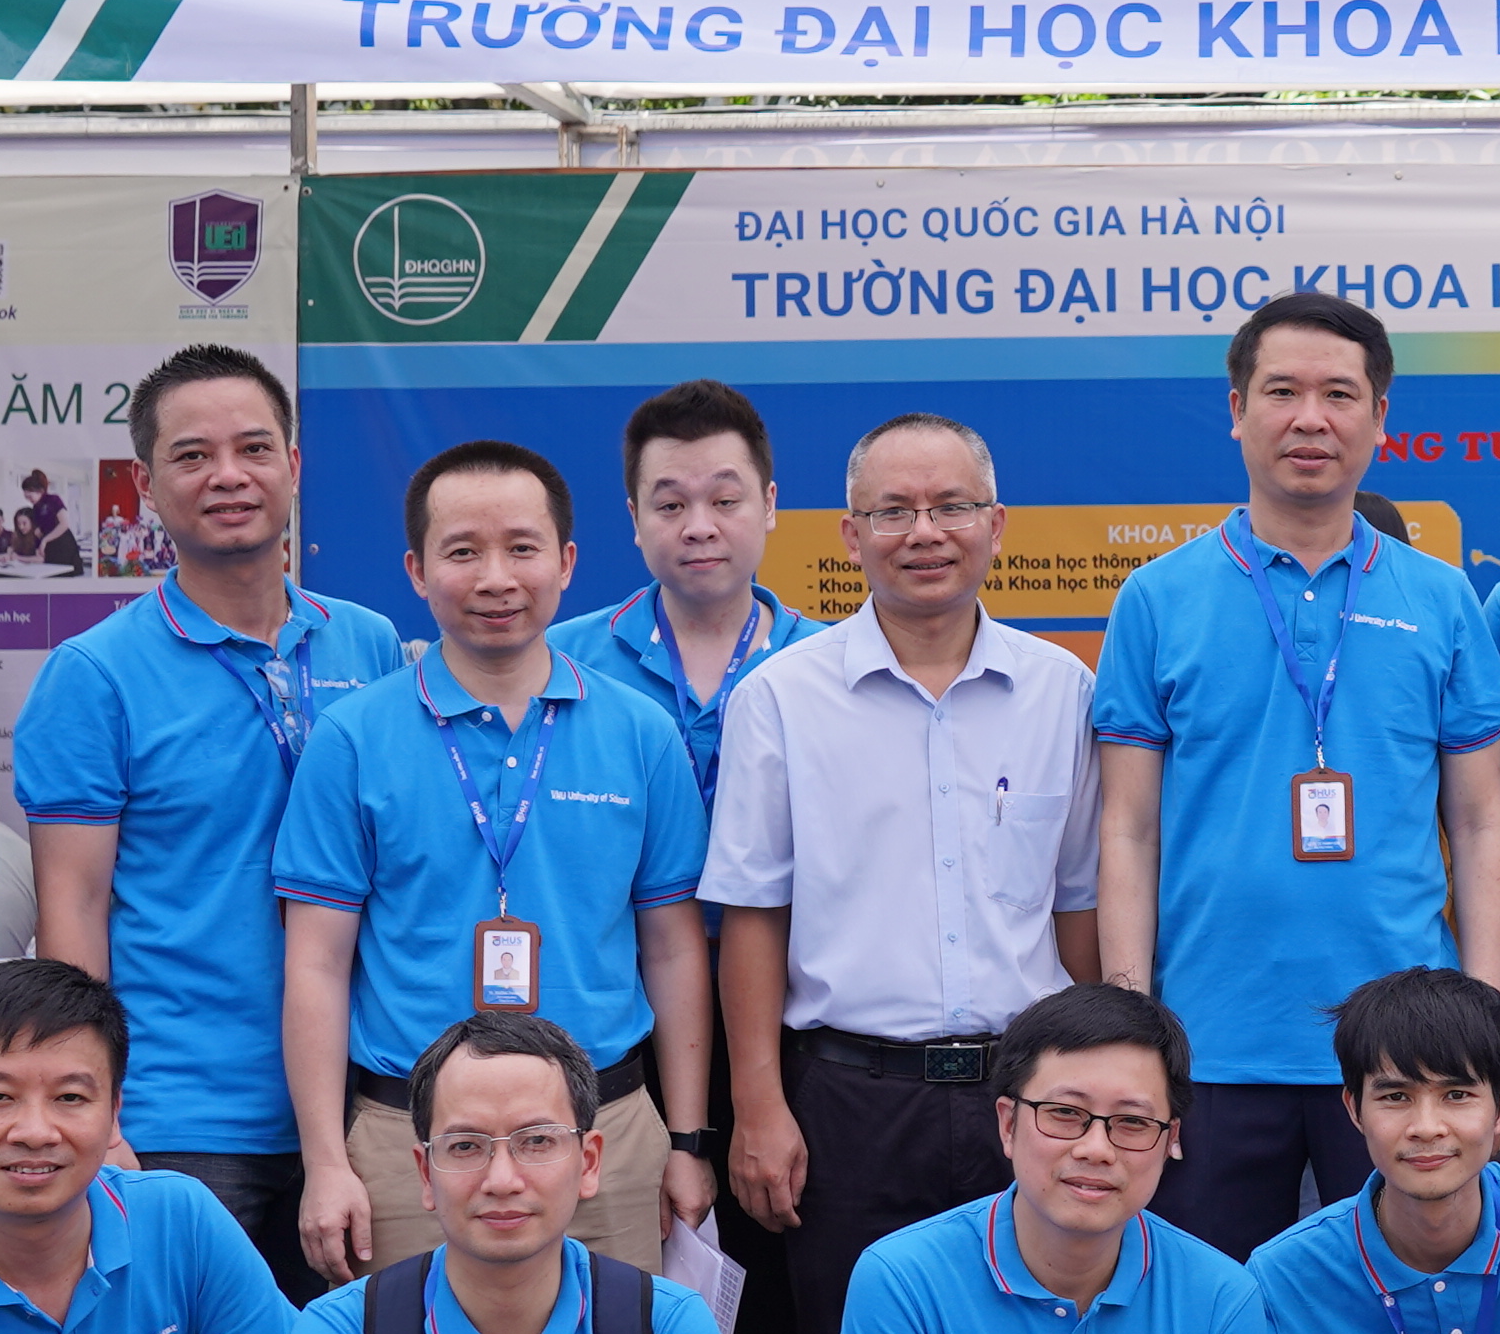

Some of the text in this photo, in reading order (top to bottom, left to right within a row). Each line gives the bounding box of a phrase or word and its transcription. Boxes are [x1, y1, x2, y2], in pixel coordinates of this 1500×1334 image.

[774, 4, 930, 65] ĐẠI
[967, 0, 1166, 69] HỌC
[735, 197, 1286, 247] ĐẠI HỌC QUỐC GIA HÀ NỘI
